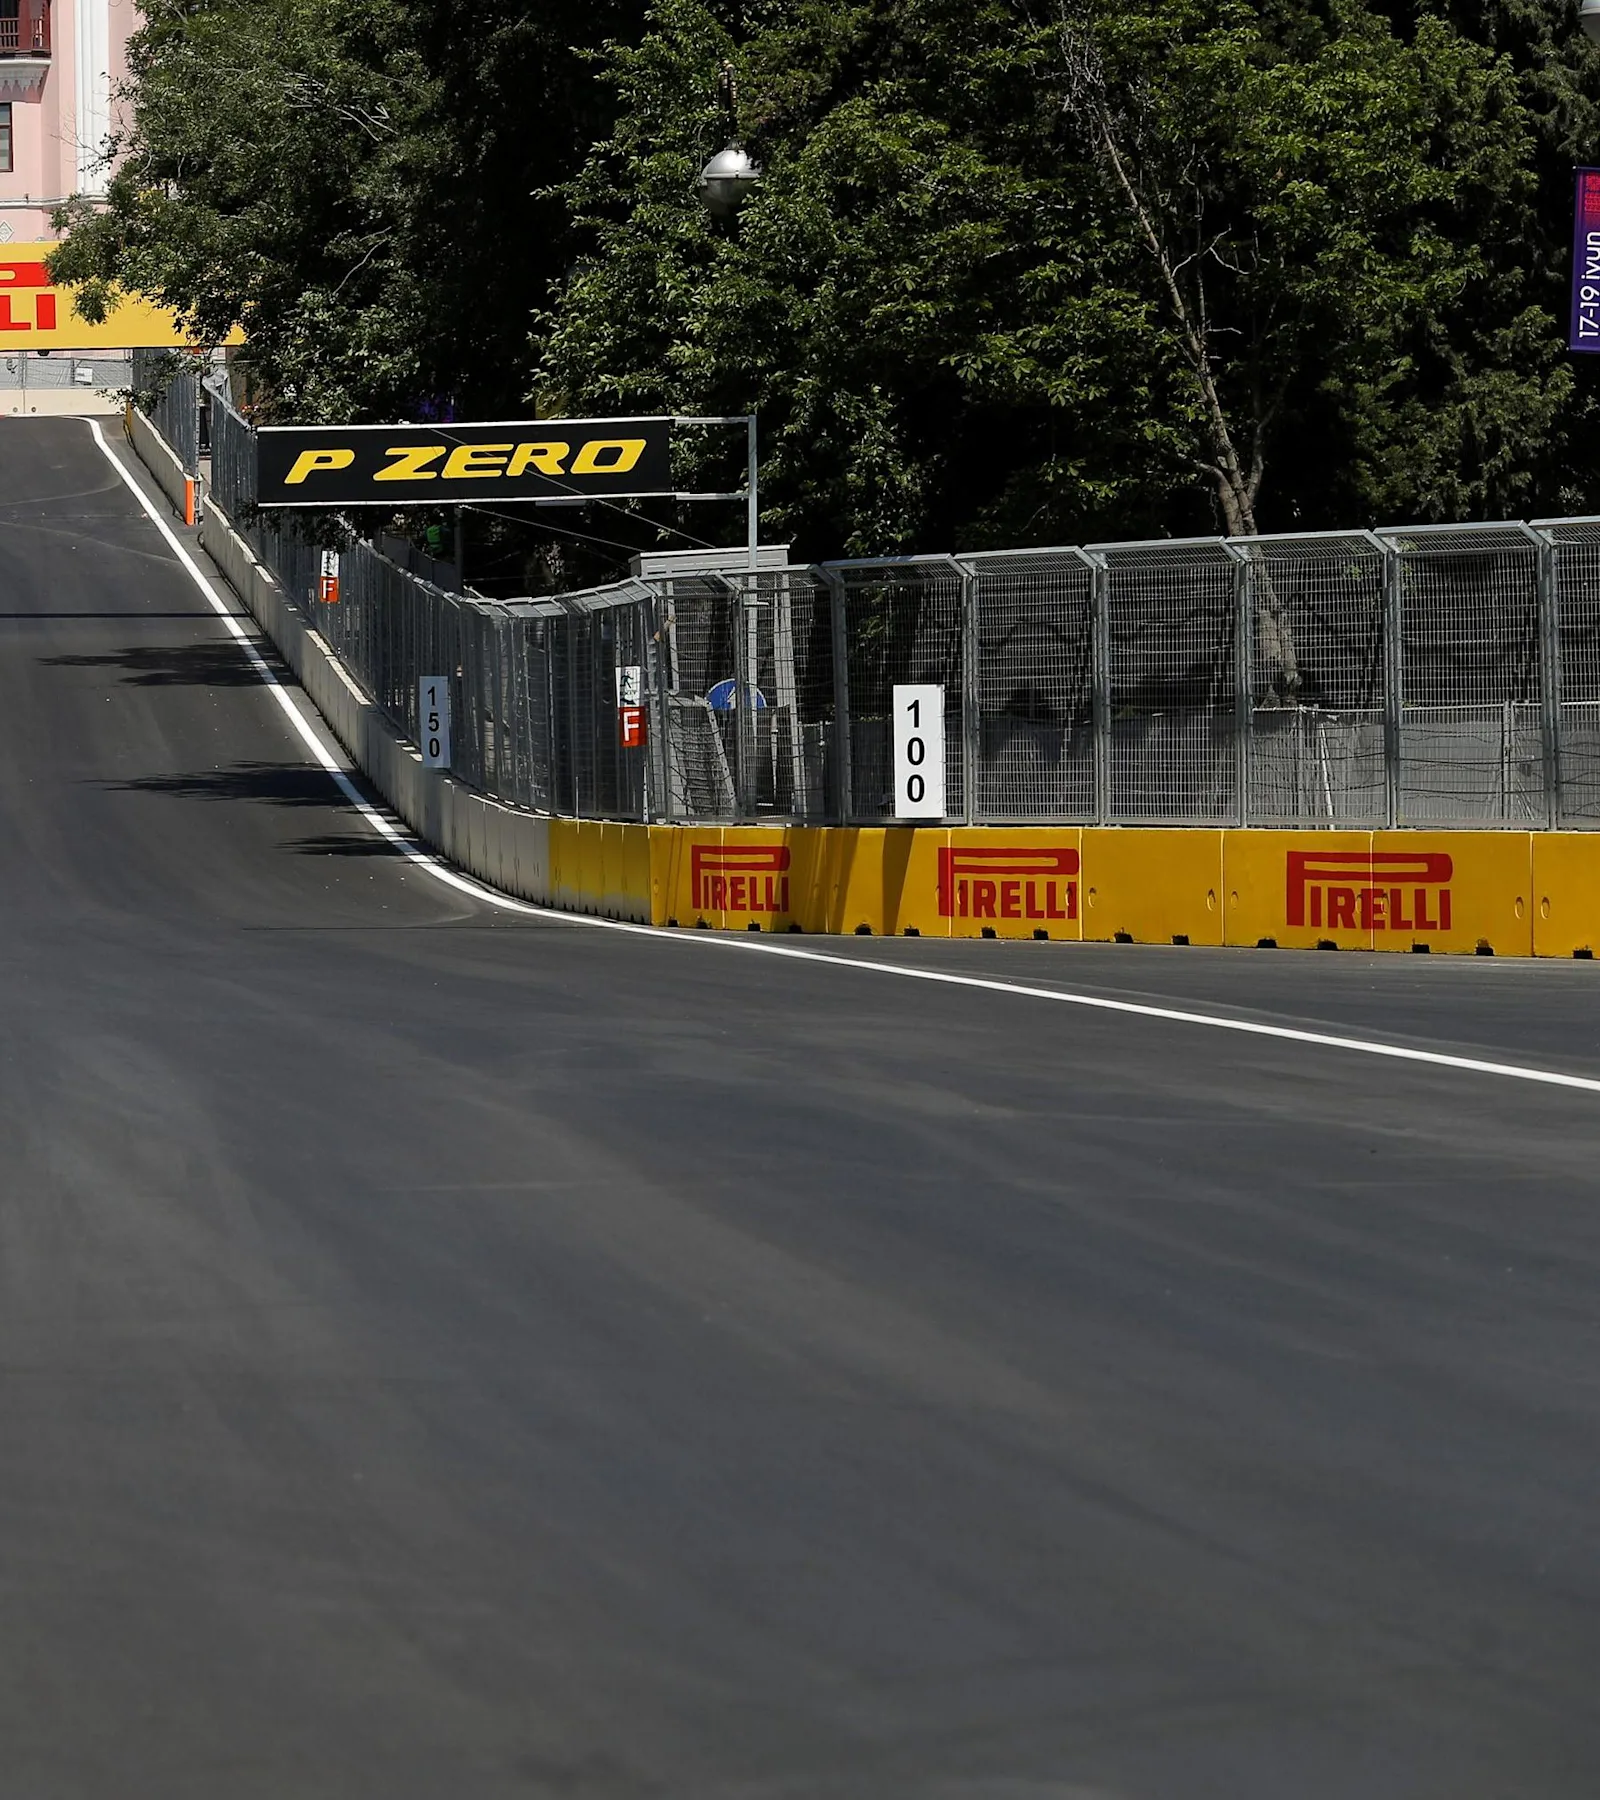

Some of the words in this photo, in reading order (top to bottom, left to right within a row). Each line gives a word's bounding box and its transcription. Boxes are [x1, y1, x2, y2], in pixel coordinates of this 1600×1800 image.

[1580, 286, 1600, 338] 17-19
[284, 449, 355, 484] P
[373, 439, 647, 481] ZERO
[322, 579, 335, 599] F
[427, 686, 441, 758] 150
[623, 711, 640, 741] F
[905, 699, 926, 803] 100
[691, 845, 791, 912] PIRELLI
[938, 847, 1080, 919] PIRELLI
[1286, 851, 1454, 930] PIRELLI
